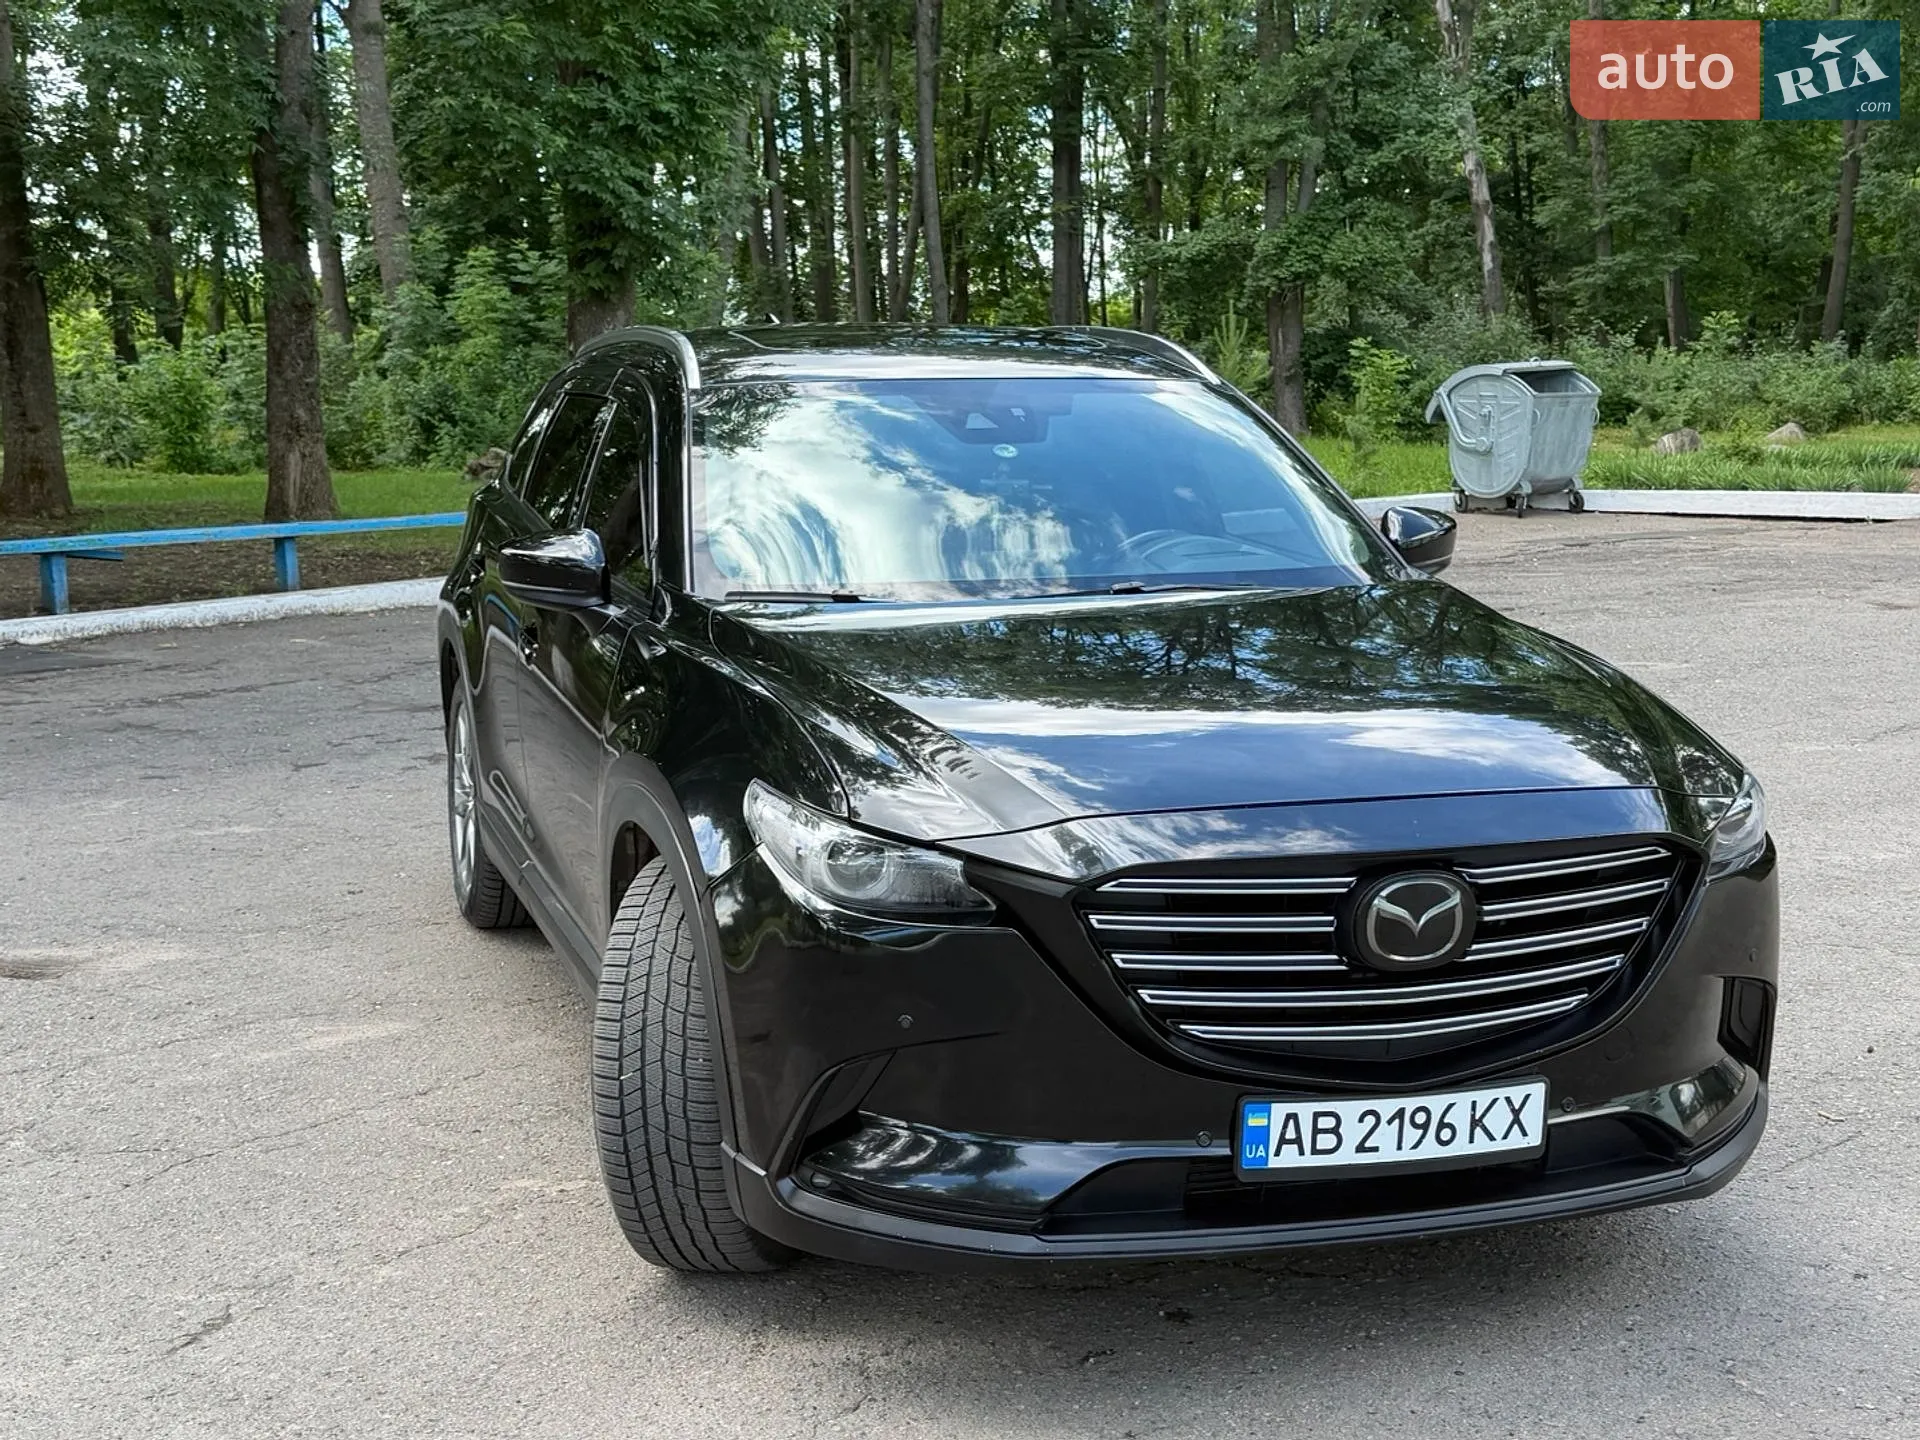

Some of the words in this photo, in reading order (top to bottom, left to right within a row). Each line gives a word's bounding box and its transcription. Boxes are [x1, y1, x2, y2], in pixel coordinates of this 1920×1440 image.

[1273, 1110, 1343, 1157] AB
[1354, 1102, 1457, 1154] 2196
[1468, 1093, 1532, 1144] KX
[1246, 1143, 1265, 1159] UA
